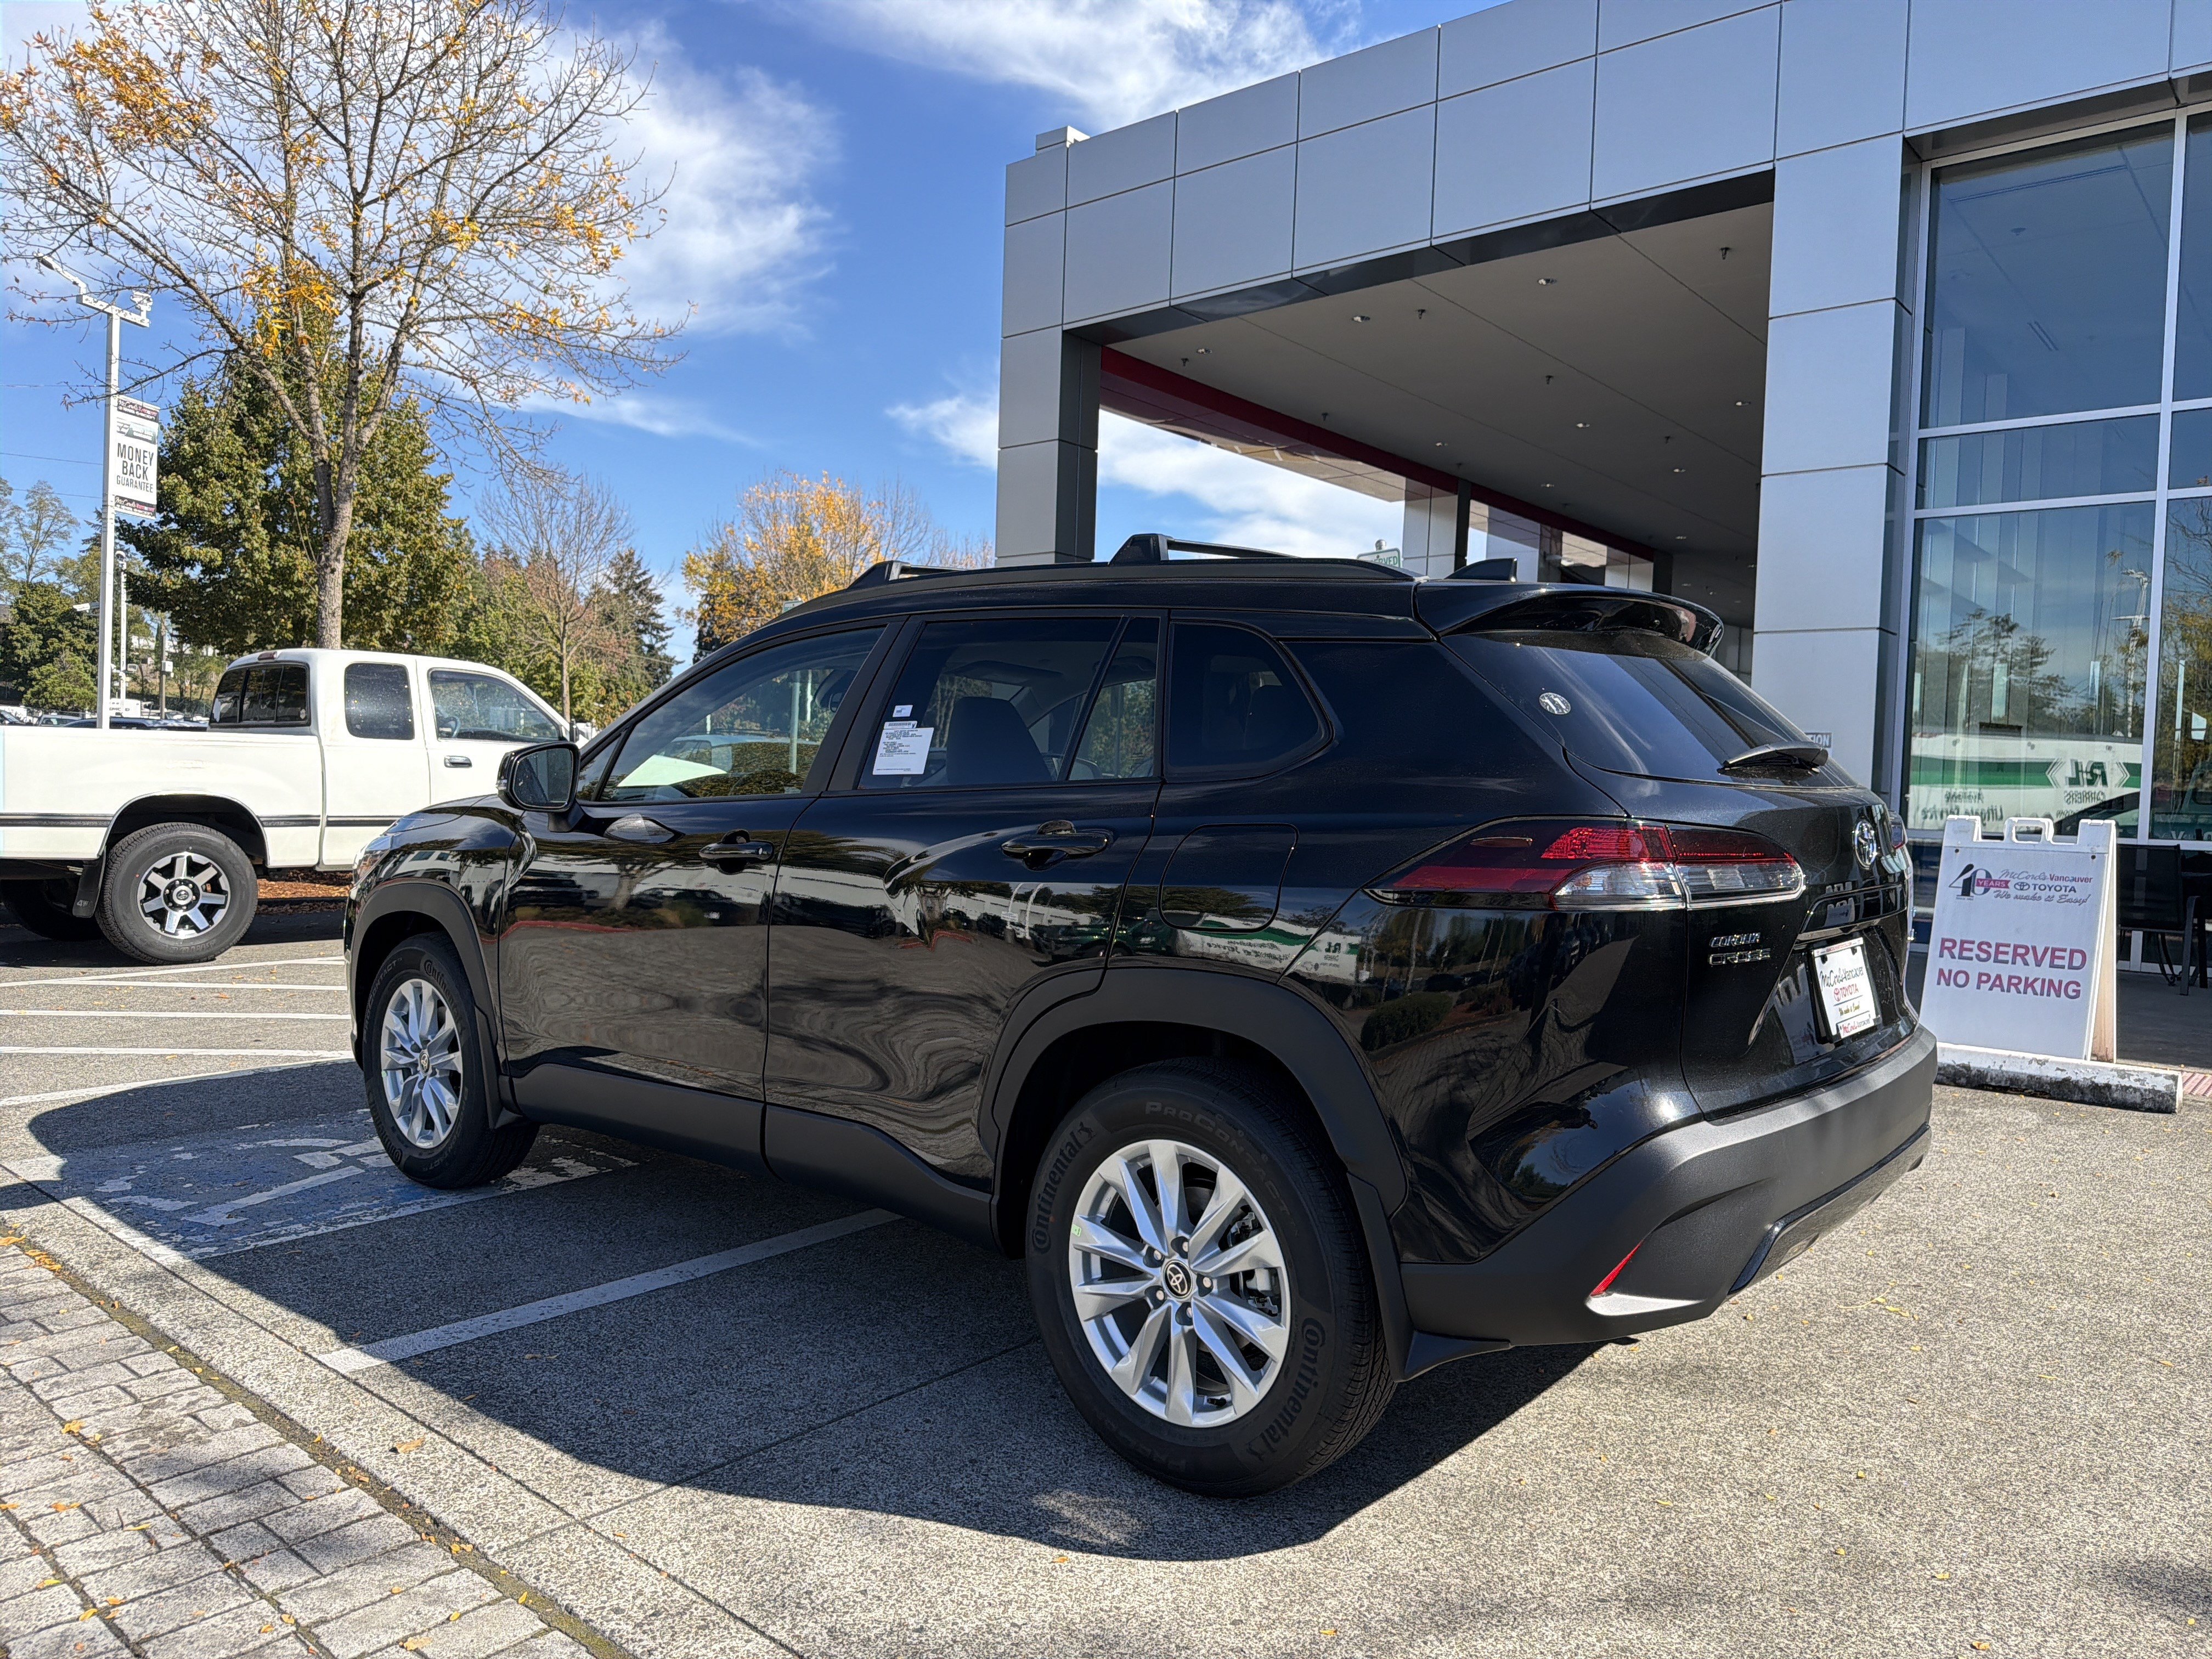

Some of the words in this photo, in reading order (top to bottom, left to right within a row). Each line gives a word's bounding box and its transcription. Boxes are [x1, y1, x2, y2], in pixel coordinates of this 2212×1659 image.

[117, 443, 154, 466] MONEY
[122, 460, 149, 481] BACK
[116, 475, 154, 493] GUARANTEE
[1948, 863, 1993, 896] 40
[1977, 879, 2006, 888] YEARS
[2032, 883, 2076, 893] TOYOTA
[2049, 873, 2093, 883] Vancouver
[1938, 937, 2087, 970] RESERVED
[1839, 983, 1859, 998] TOYOTA
[1937, 967, 1970, 988] NO
[1976, 971, 2081, 1000] PARKING
[1031, 1131, 1083, 1255] Continental
[1261, 1317, 1326, 1453] Continental
